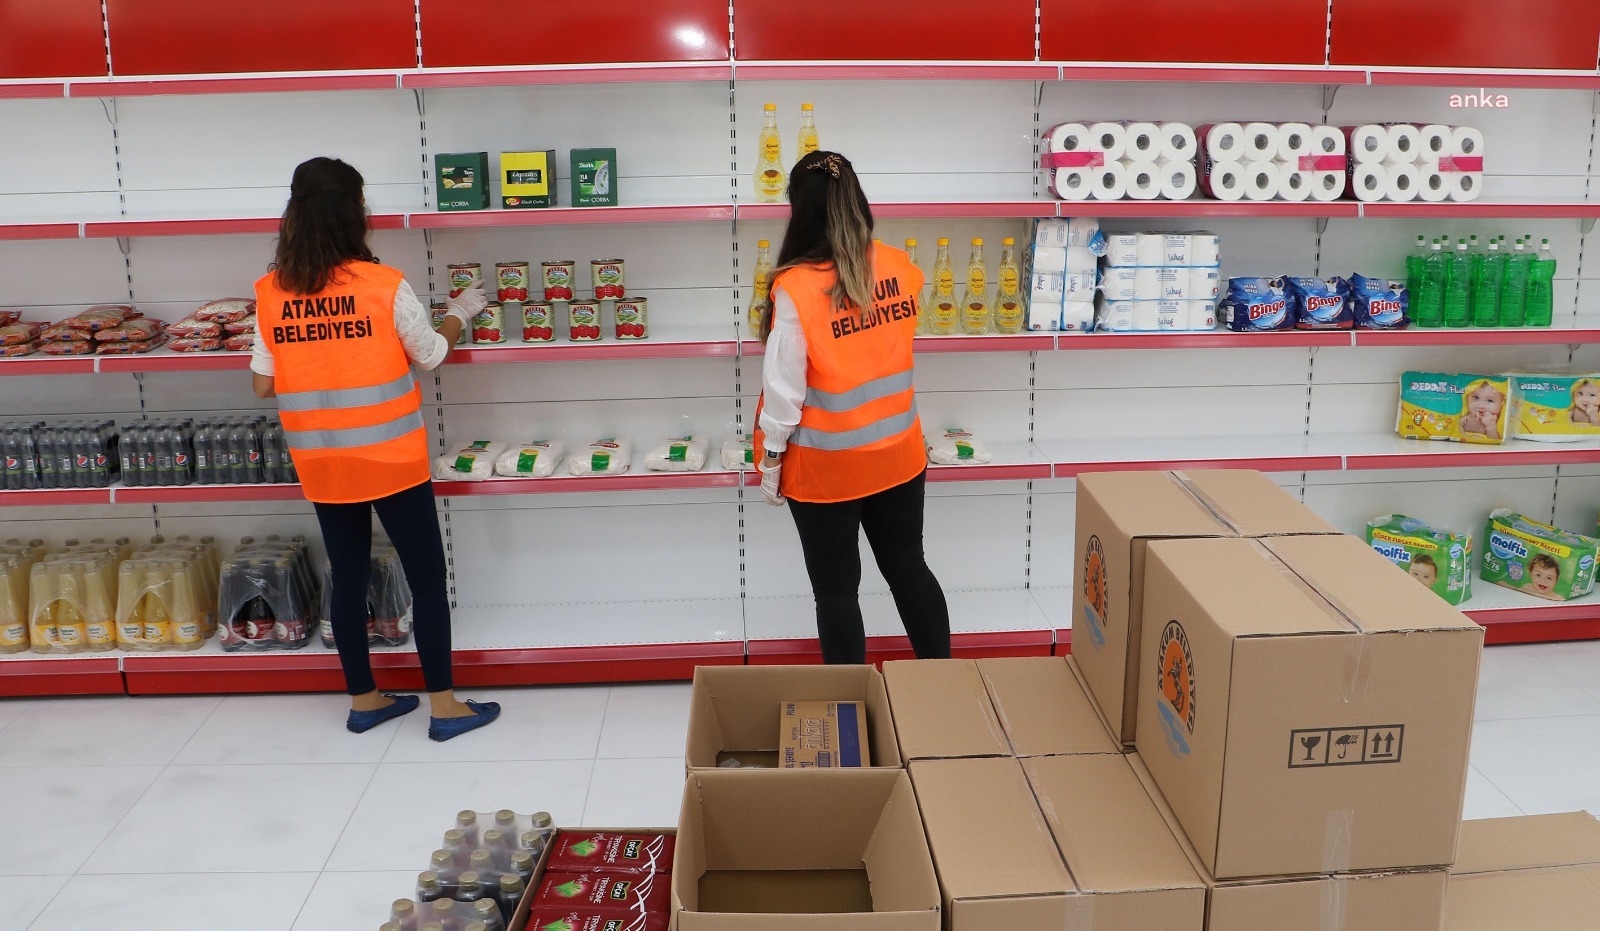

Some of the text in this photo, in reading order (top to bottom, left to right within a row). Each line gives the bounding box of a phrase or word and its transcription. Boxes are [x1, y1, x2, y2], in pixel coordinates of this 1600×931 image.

[281, 295, 356, 320] ATAKUM
[1249, 299, 1286, 320] Bingo
[1306, 295, 1342, 311] Bingo
[273, 315, 373, 344] BELEDİYESİ
[1490, 534, 1528, 558] molfix
